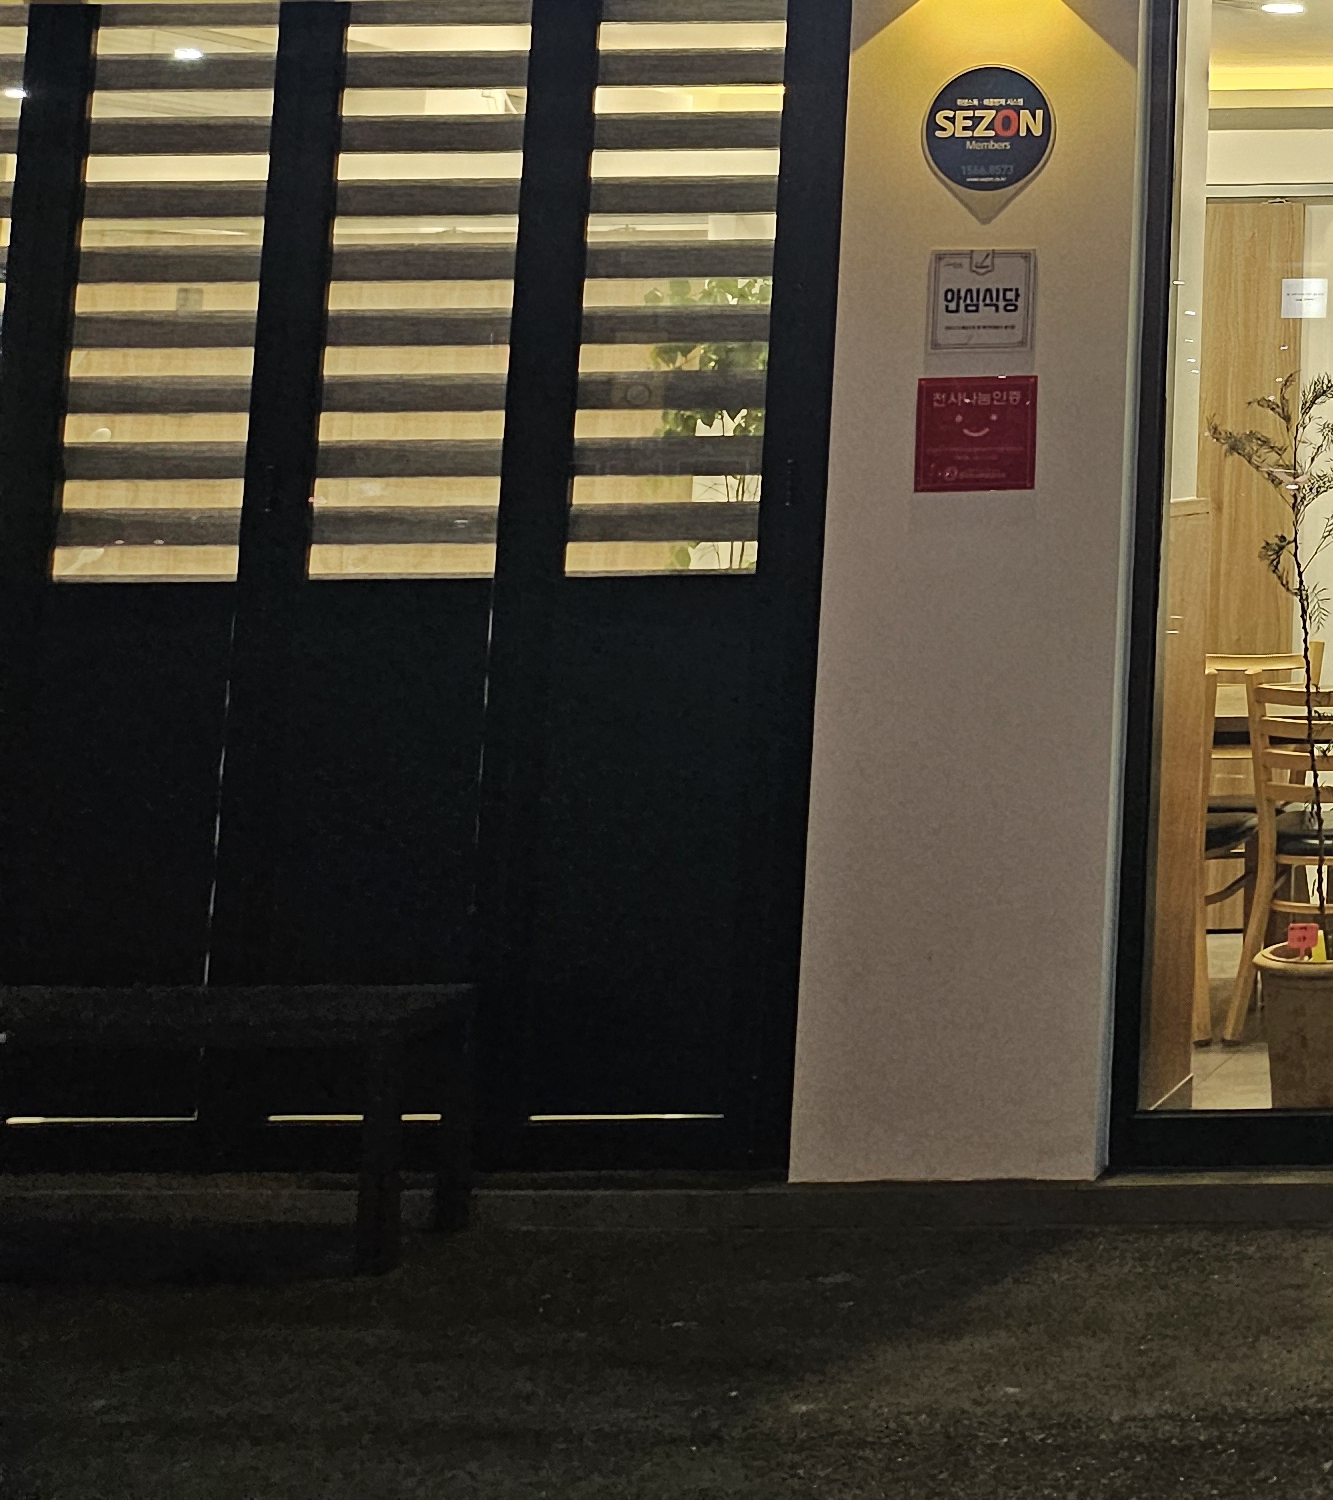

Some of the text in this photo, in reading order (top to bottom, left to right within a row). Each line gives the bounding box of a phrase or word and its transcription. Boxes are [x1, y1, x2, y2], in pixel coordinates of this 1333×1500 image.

[935, 108, 1044, 138] SEZON
[965, 139, 1011, 150] Members
[943, 287, 1021, 314] 안심식당
